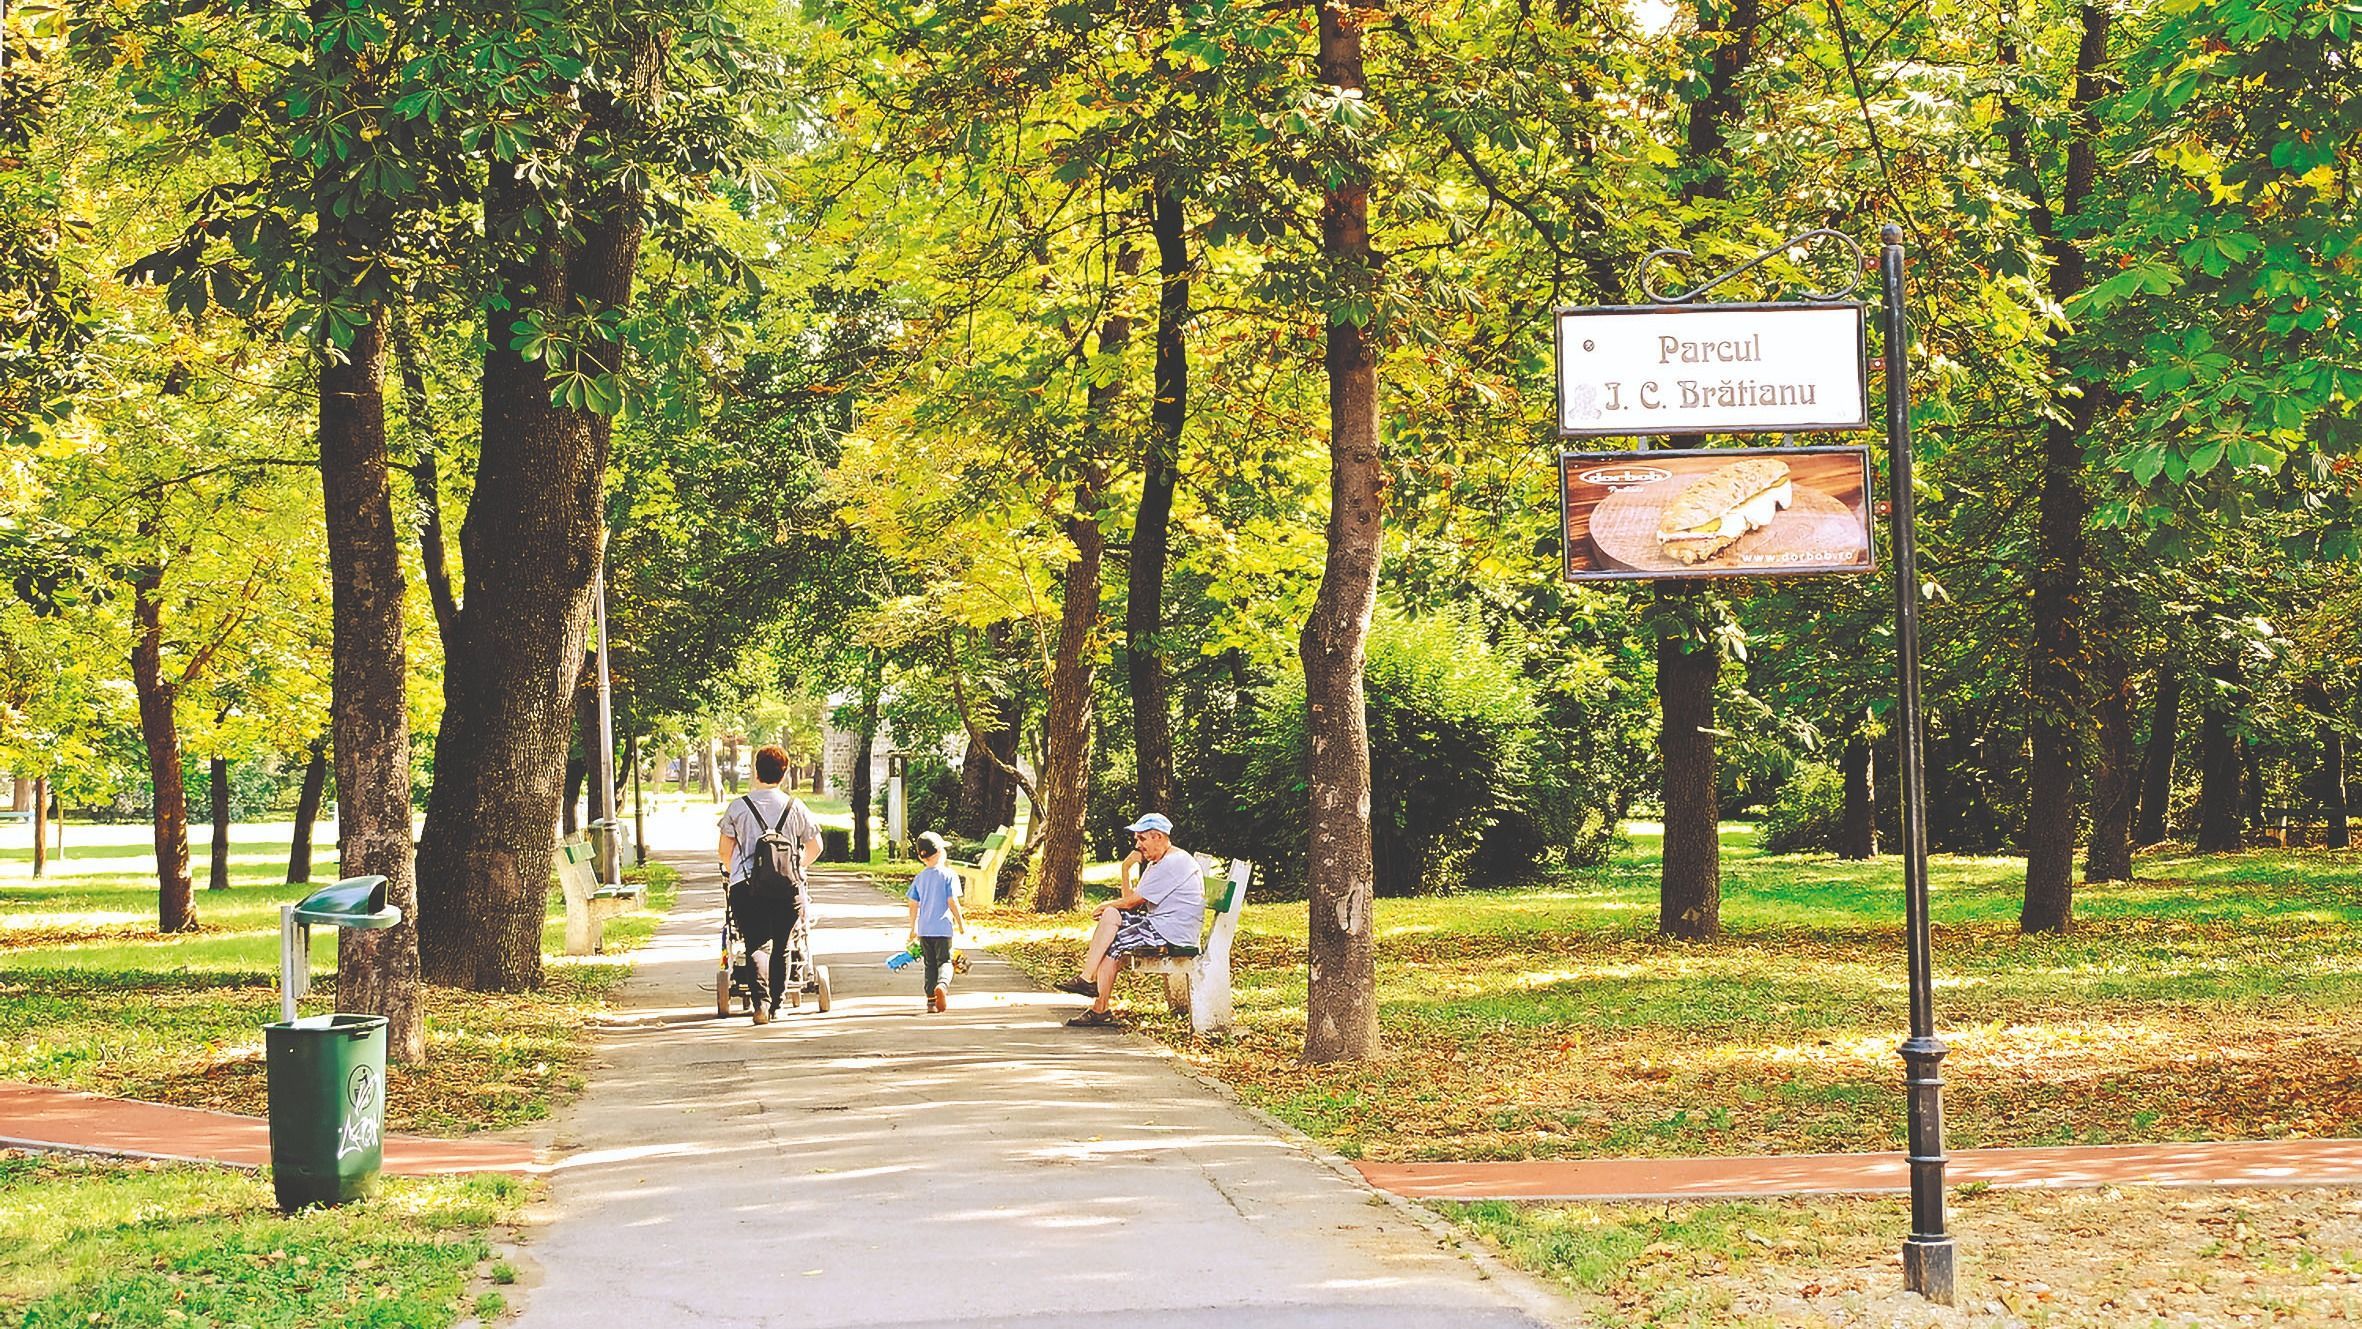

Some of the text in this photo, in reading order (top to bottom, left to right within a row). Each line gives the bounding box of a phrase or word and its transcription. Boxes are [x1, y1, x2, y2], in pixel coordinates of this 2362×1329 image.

[1658, 333, 1762, 364] Parcul
[1640, 381, 1668, 410] C.
[1676, 379, 1817, 409] Brătianu
[1741, 550, 1853, 563] www.dorbob.ro
